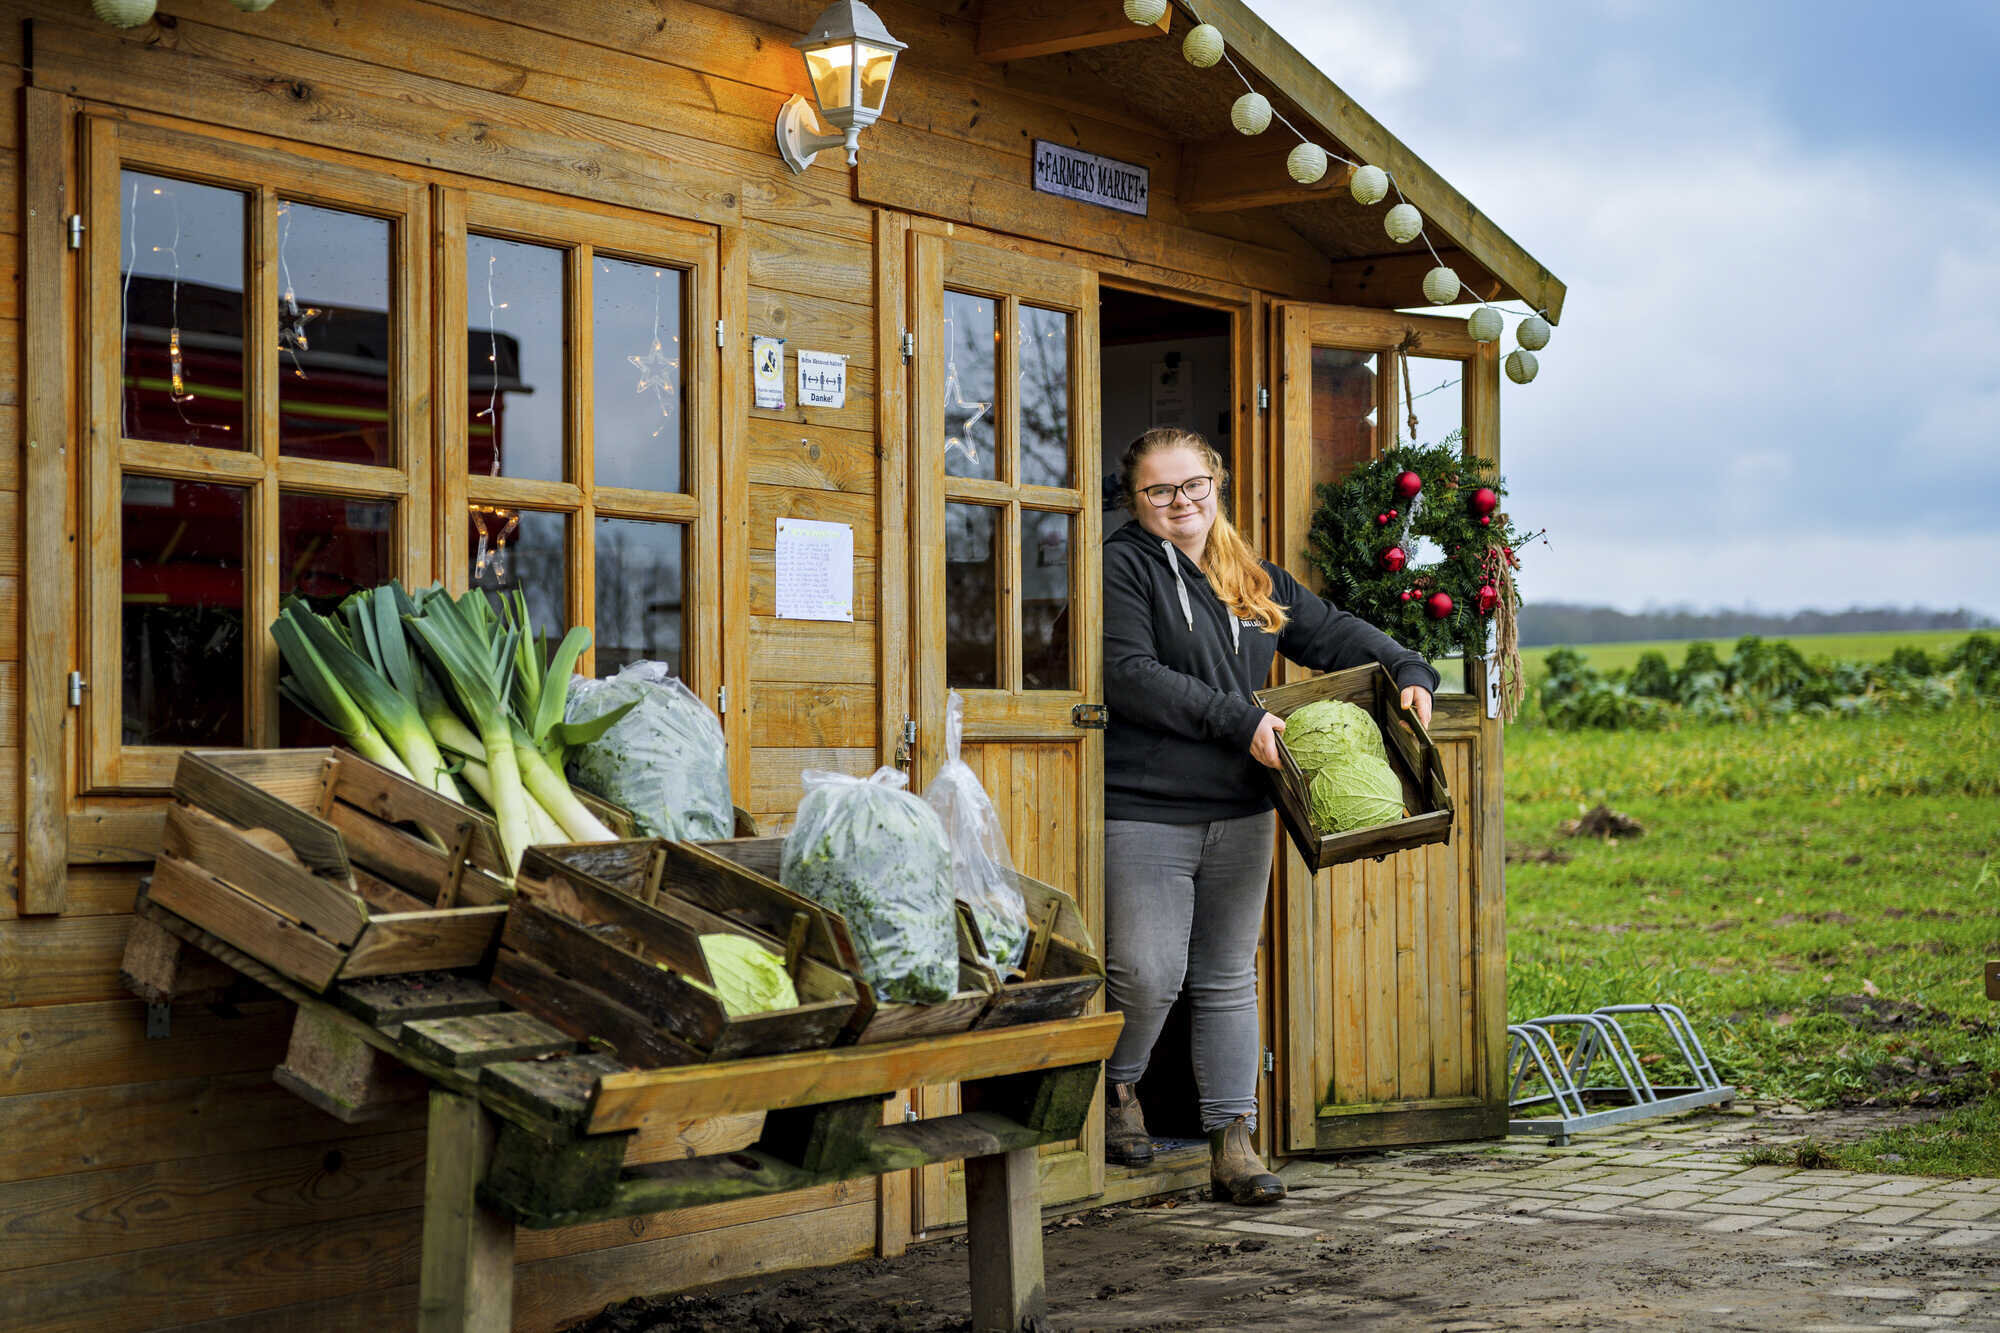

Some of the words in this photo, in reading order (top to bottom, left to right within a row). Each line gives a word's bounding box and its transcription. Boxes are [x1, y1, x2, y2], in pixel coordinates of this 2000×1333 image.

[1045, 151, 1095, 193] FARMERS
[1097, 166, 1141, 204] MARKET
[811, 393, 833, 403] Danke!
